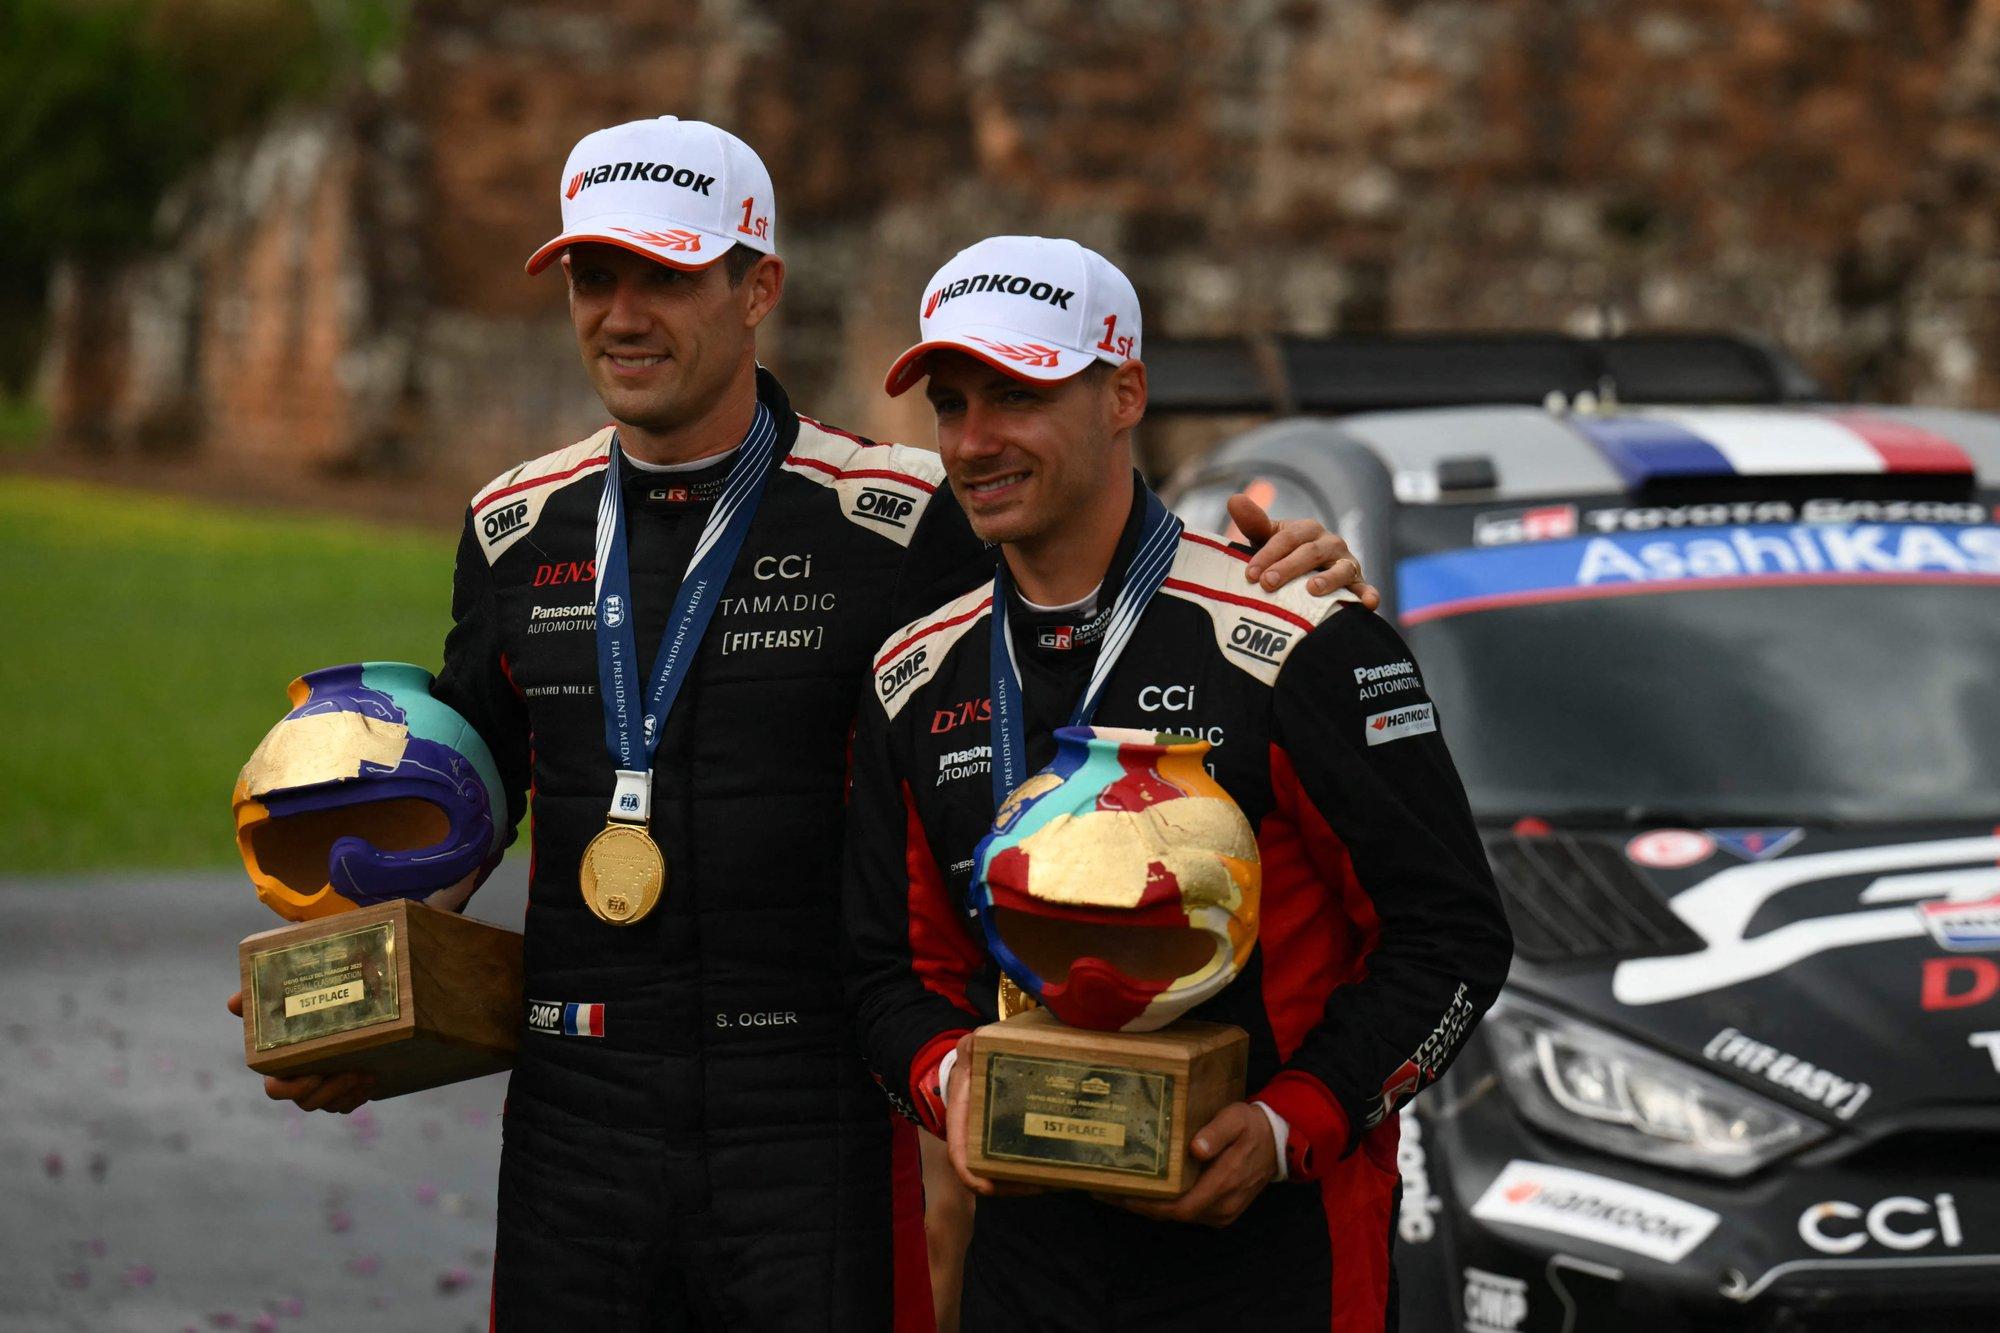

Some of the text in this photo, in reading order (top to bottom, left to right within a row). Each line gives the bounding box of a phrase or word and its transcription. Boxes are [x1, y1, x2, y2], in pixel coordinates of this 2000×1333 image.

[737, 197, 769, 241] 1st
[1097, 314, 1134, 360] 1st
[650, 488, 686, 501] GR
[856, 491, 913, 520] OMP
[484, 503, 529, 539] OMP
[611, 641, 621, 658] FIA
[653, 579, 708, 702] FIA PRESIDENT'S MEDAL
[1040, 634, 1070, 648] GR
[1231, 623, 1288, 657] OMP
[881, 649, 927, 696] OMP
[1353, 659, 1414, 685] Panasonic
[525, 685, 596, 697] RICHARD MILLE
[613, 661, 628, 728] PRESIDENT'S
[999, 678, 1008, 715] MEDAL
[1001, 718, 1013, 787] PRESIDENT'S
[300, 988, 350, 1008] 1ST PLACE
[529, 1004, 560, 1028] OMP
[716, 1011, 798, 1028] S. OGIER
[1410, 981, 1468, 1063] TOYOTA
[1043, 1120, 1107, 1137] 1ST PLACE
